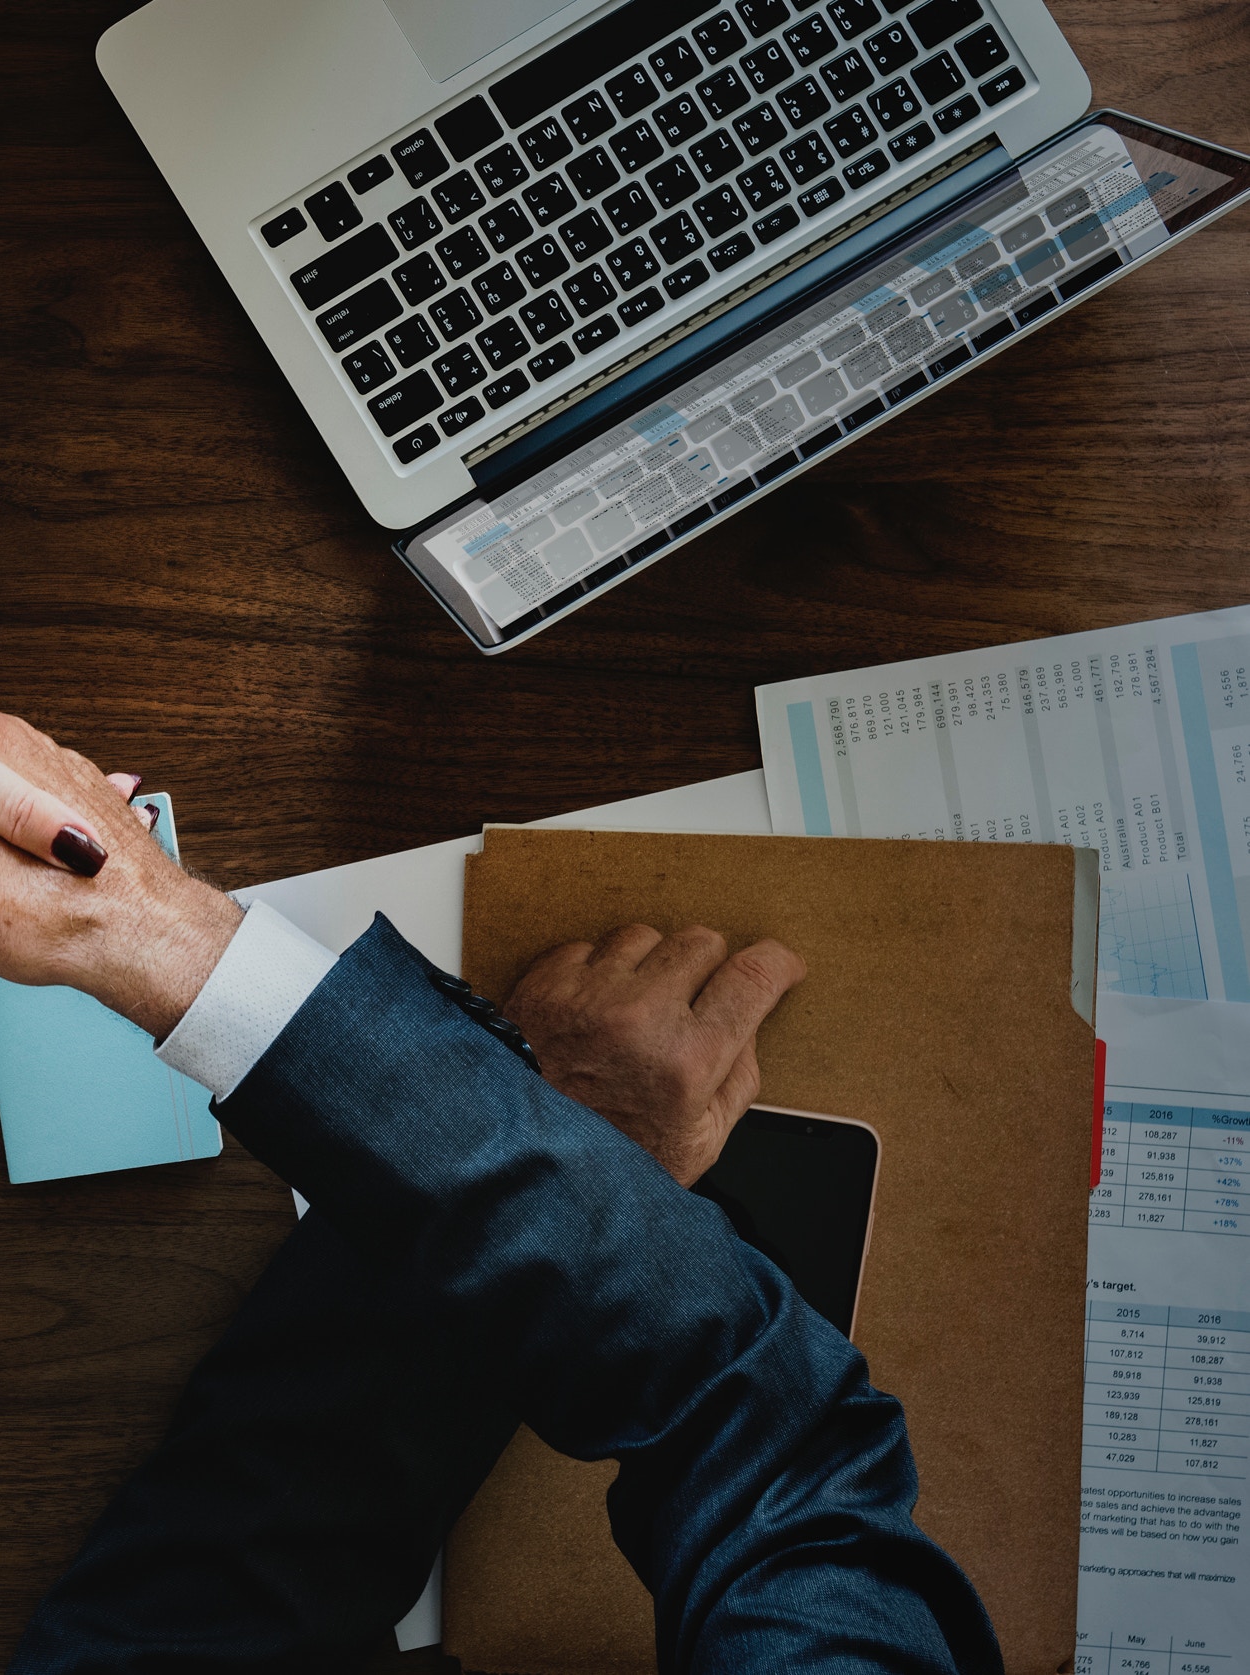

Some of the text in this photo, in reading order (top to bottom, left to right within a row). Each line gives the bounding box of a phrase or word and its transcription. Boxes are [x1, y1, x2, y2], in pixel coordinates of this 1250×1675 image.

[994, 79, 1010, 91] esc
[399, 138, 424, 157] option
[413, 171, 423, 180] alt
[300, 268, 318, 284] shift
[325, 307, 349, 325] return
[337, 328, 354, 342] enter
[377, 390, 402, 409] delete
[1070, 660, 1084, 698] 45,000
[1109, 653, 1124, 698] 182,790
[996, 672, 1011, 710] 75,380
[895, 688, 910, 734] 421,045
[845, 697, 861, 743] 976,819
[1149, 793, 1169, 862] Product B01
[1092, 801, 1112, 871] Product A03
[1116, 817, 1131, 868] Australia
[1173, 831, 1186, 860] Total
[1149, 1109, 1173, 1120] 2016
[1144, 1129, 1178, 1140] 108,287
[1147, 1150, 1176, 1161] 91,938
[1218, 1156, 1243, 1167] +37%
[1217, 1178, 1241, 1187] +42%
[1213, 1219, 1238, 1229] +18%
[1102, 1280, 1136, 1293] target.
[1116, 1307, 1141, 1319] 2015
[1197, 1313, 1222, 1325] 2016
[1120, 1329, 1145, 1339] 8,714
[1112, 1369, 1142, 1380] 89,918
[1105, 1410, 1138, 1421] 189,128
[1105, 1452, 1135, 1463] 47,029
[1107, 1489, 1242, 1506] opportunities to increase sales
[1127, 1634, 1146, 1646] May
[1184, 1639, 1206, 1649] June
